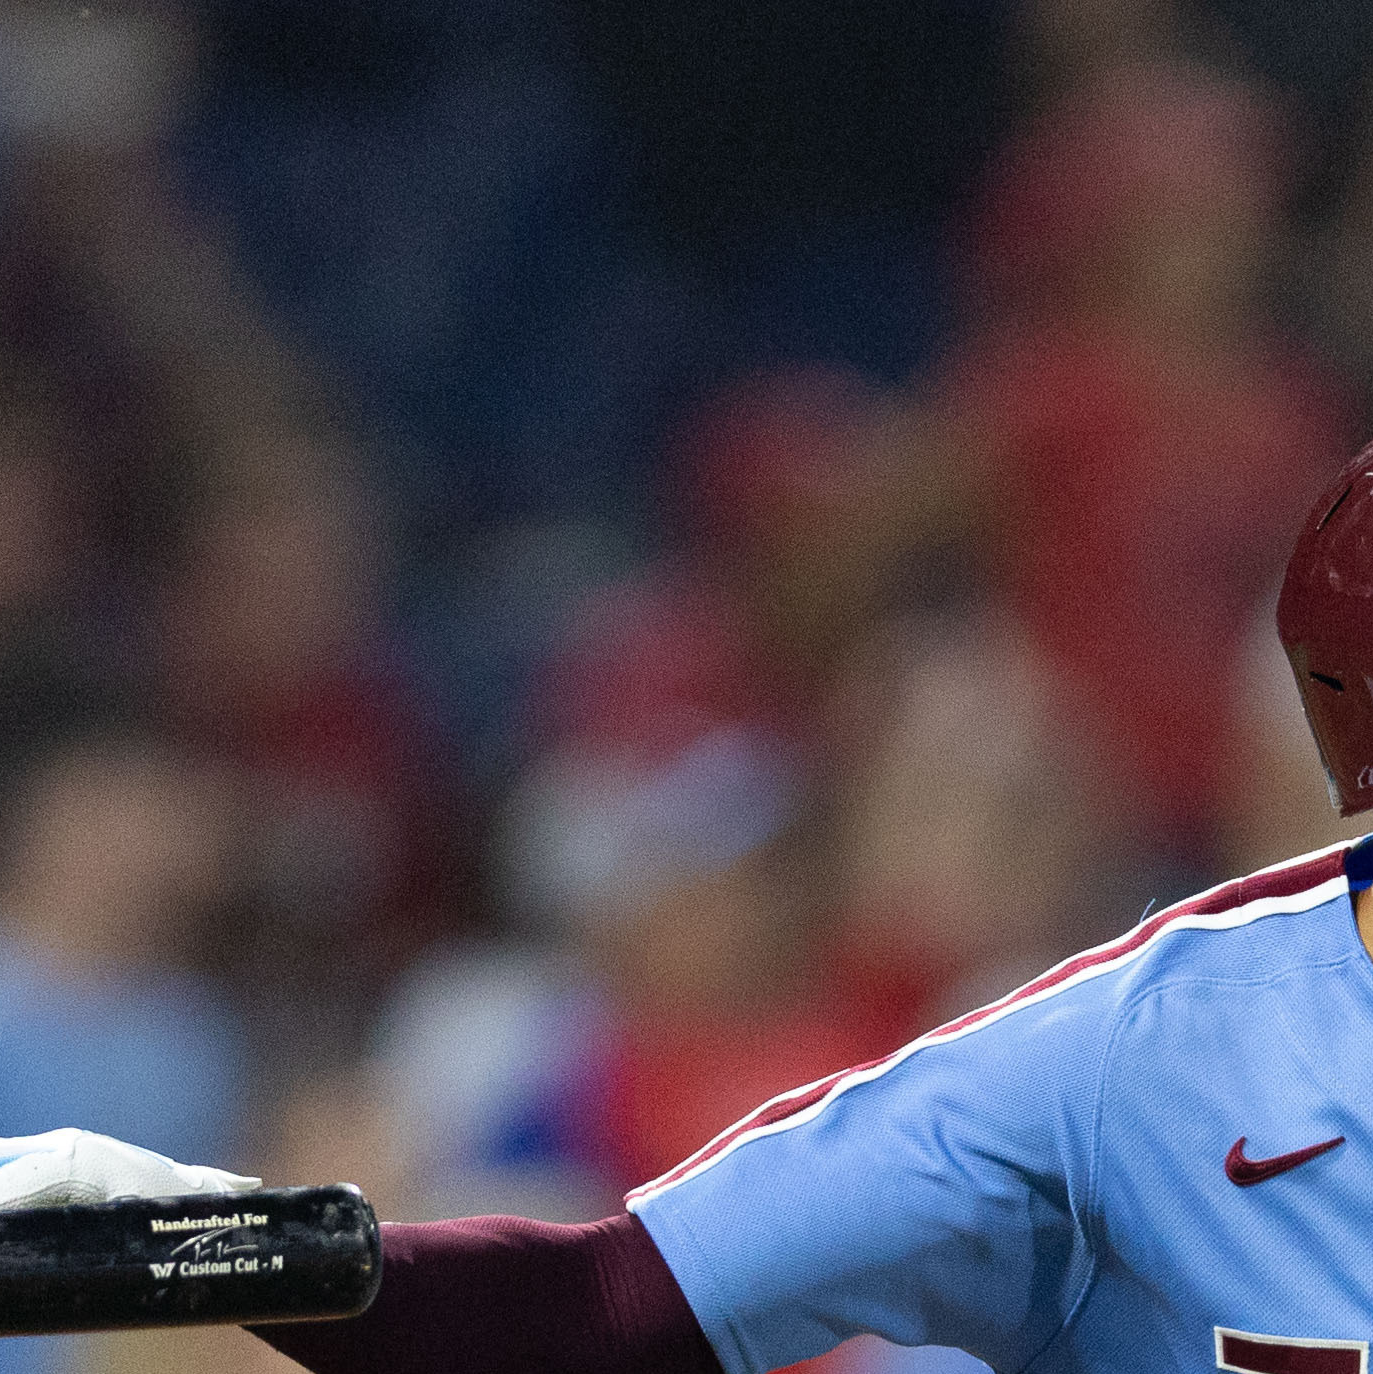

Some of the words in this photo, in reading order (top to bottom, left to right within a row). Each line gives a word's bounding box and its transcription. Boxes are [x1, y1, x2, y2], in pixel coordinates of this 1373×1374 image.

[151, 1213, 241, 1233] Handcrafted
[243, 1212, 269, 1226] For
[180, 1260, 232, 1277] Custom
[235, 1257, 259, 1273] Cut
[271, 1255, 284, 1271] M
